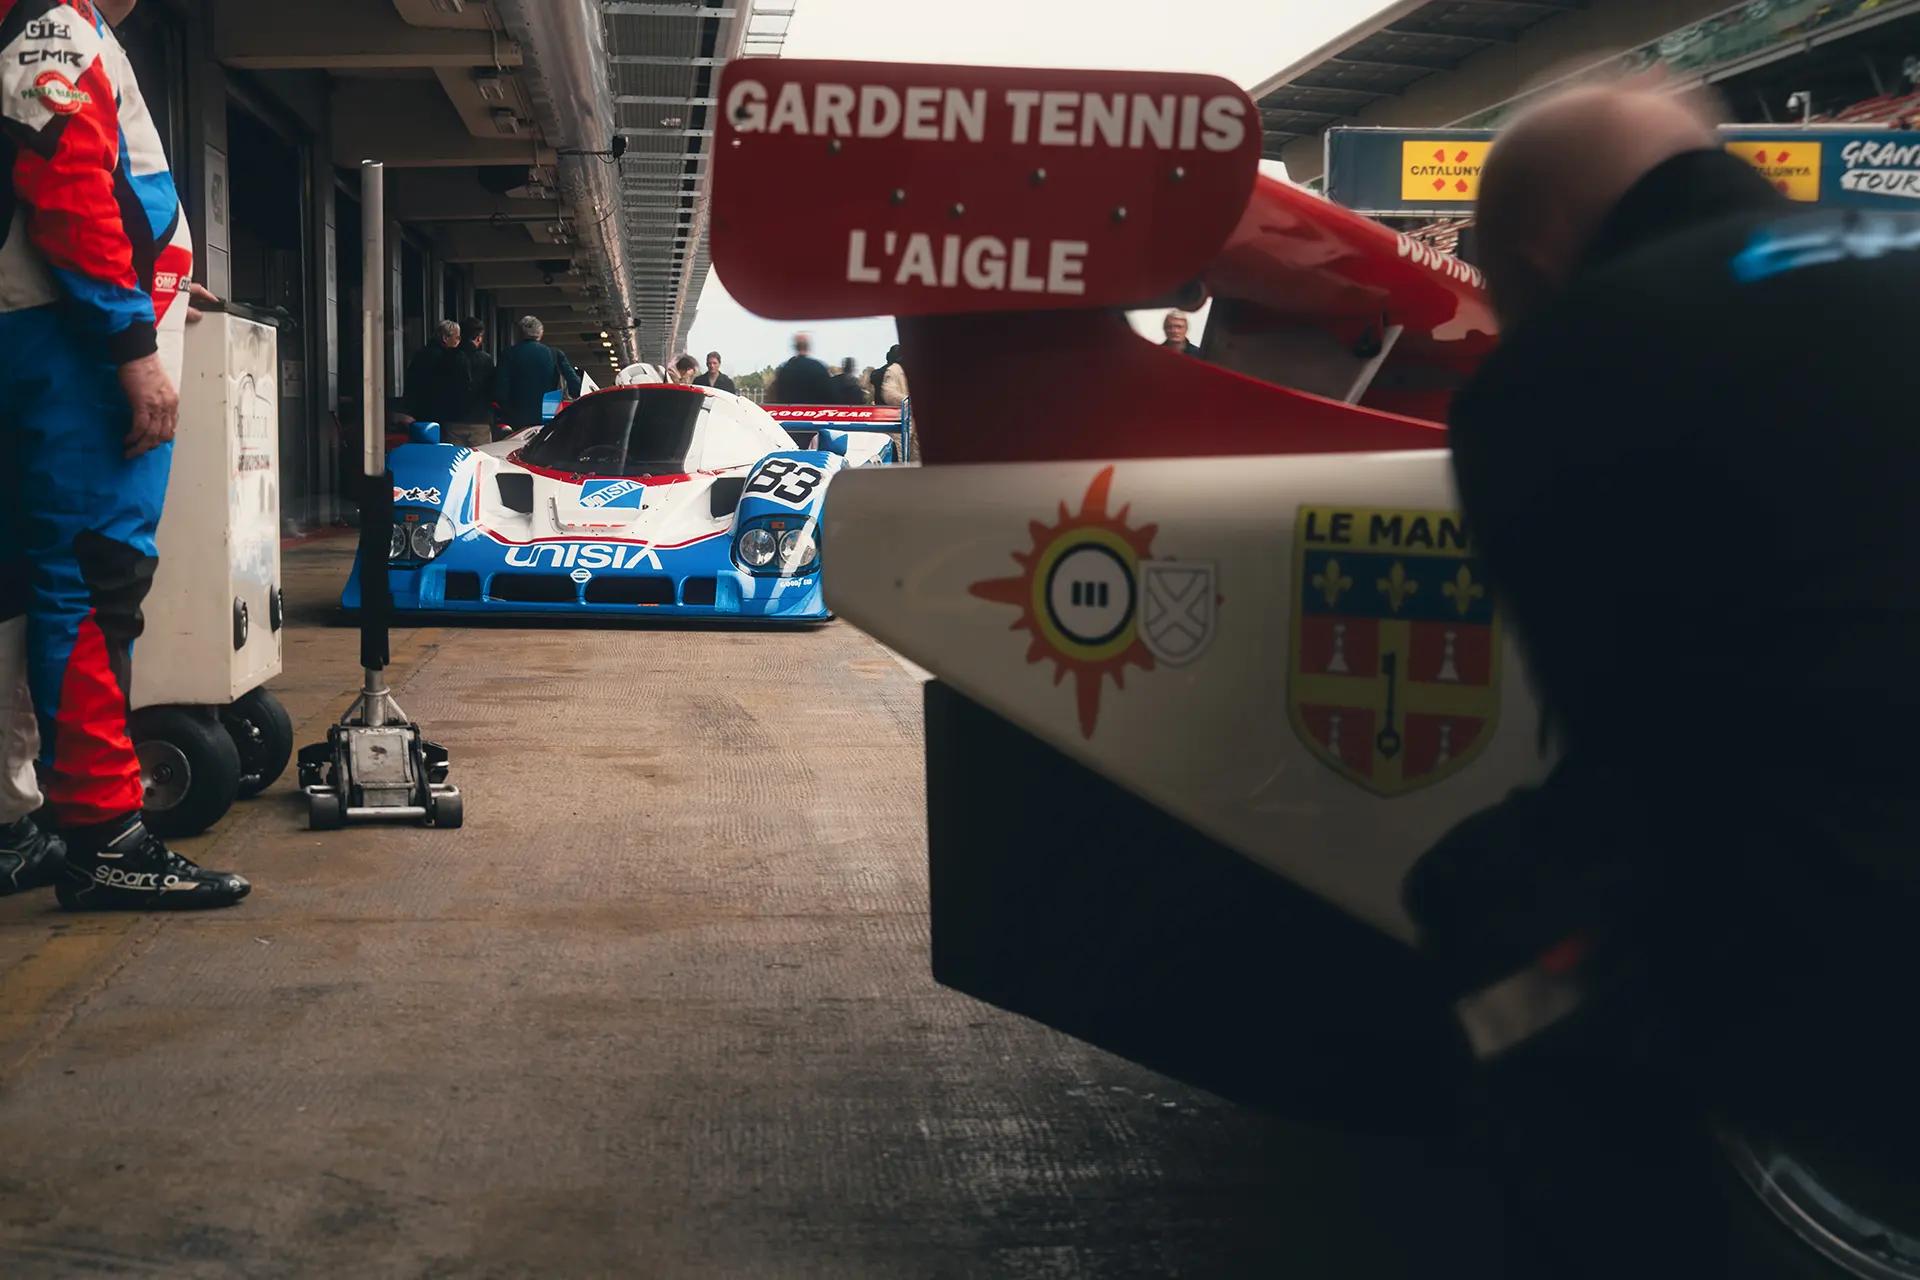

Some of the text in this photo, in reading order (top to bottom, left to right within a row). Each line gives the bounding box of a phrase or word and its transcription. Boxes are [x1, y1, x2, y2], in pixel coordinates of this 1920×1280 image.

[19, 49, 84, 67] CMR
[726, 80, 1246, 151] GARDEN TENNIS
[1841, 140, 1920, 168] GRAN
[847, 230, 1088, 295] L'AIGLE
[155, 275, 177, 289] OMP
[746, 460, 822, 503] 83
[1305, 512, 1466, 549] LE MAN
[504, 544, 664, 570] UNISIA
[96, 865, 179, 886] sparco
